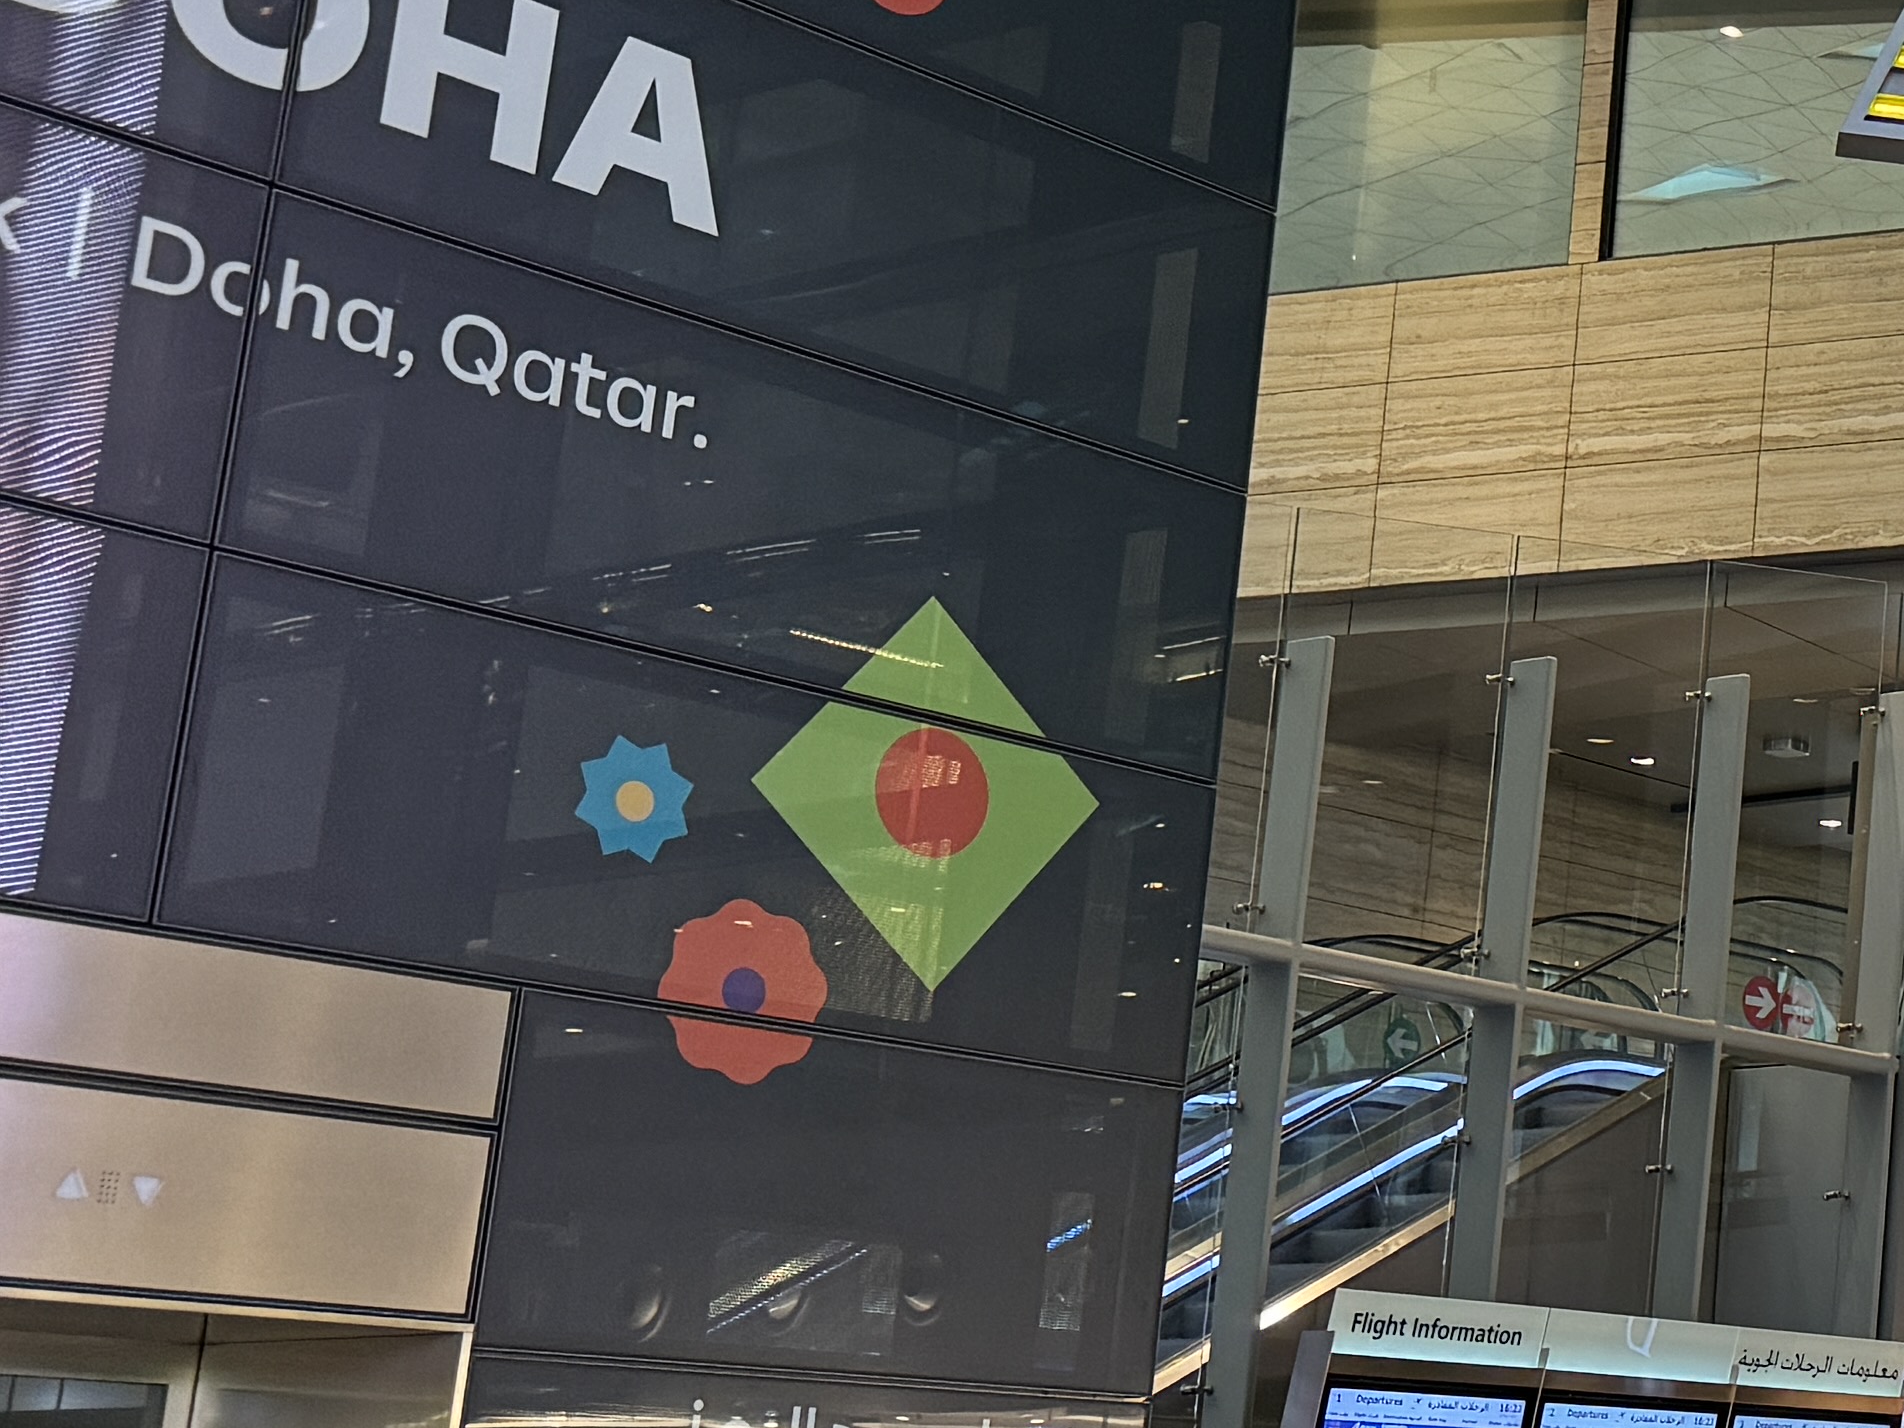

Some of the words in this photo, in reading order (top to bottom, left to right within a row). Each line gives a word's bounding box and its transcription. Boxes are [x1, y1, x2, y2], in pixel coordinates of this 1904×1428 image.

[131, 214, 415, 378] Doha,
[440, 313, 711, 449] Qatar.
[1350, 1310, 1408, 1340] Flight
[1411, 1316, 1524, 1347] Information
[1780, 1352, 1834, 1378] الرحلات
[1836, 1357, 1899, 1383] معلومات
[1356, 1394, 1403, 1407] Departures
[1567, 1408, 1609, 1419] Departures
